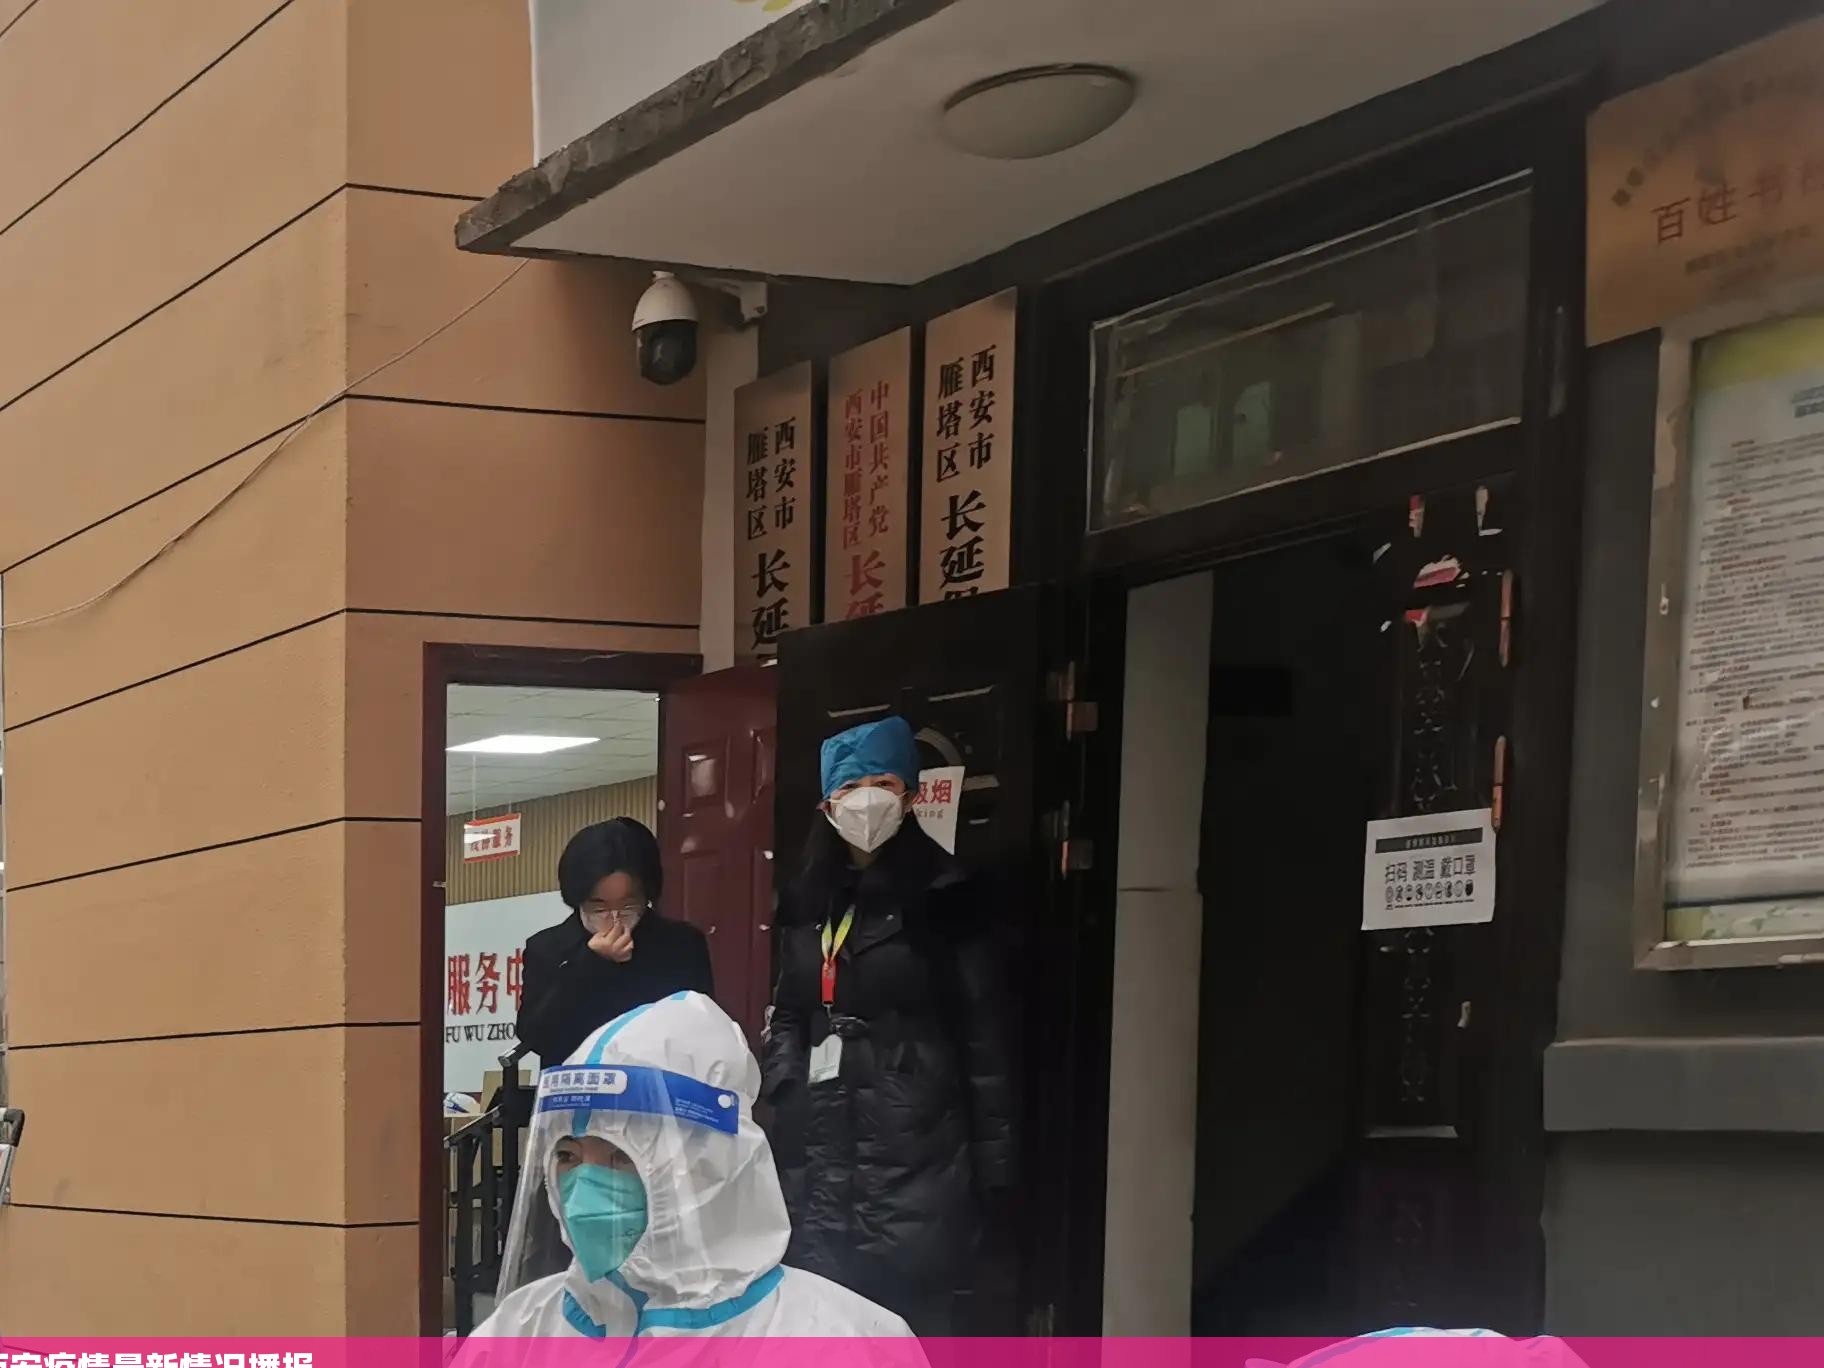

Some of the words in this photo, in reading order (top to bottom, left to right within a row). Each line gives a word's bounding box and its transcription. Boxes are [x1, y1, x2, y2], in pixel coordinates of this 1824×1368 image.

[869, 380, 890, 537] 中国共产党
[936, 357, 964, 483] 雁塔区
[968, 344, 997, 471] 西安市
[746, 426, 768, 541] 雁塔区
[773, 416, 797, 530] 西安市
[842, 388, 863, 550] 西安市雁塔区
[940, 490, 986, 600] 长延
[750, 549, 792, 664] 长延
